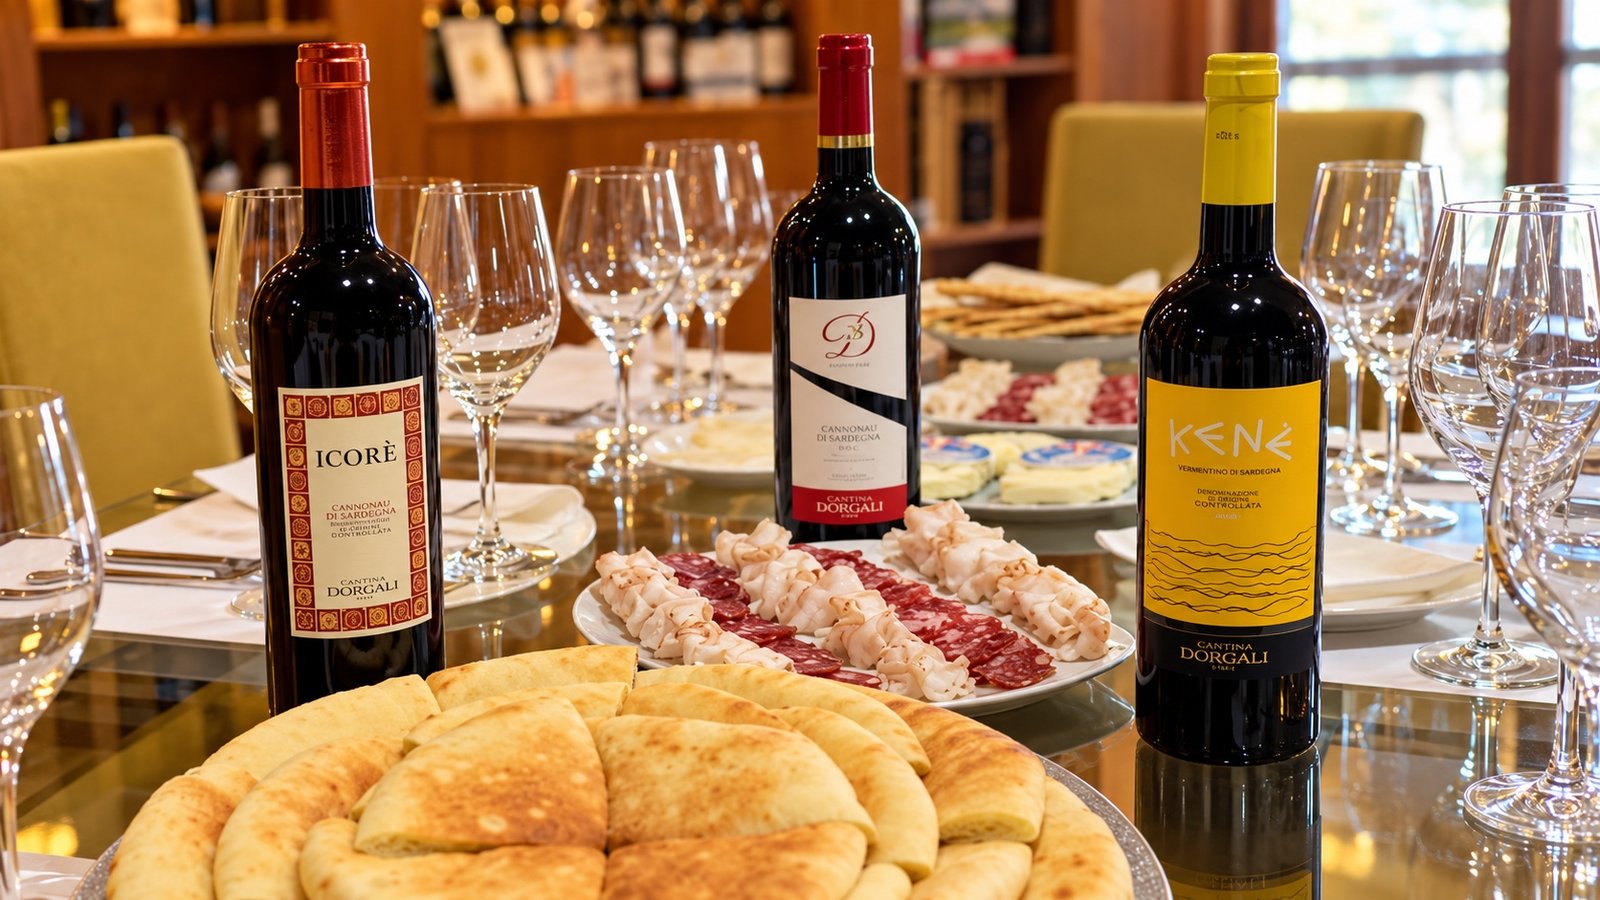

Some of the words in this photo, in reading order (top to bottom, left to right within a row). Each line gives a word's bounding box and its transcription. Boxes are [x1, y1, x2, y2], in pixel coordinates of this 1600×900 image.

[821, 424, 877, 433] CANNONAU
[817, 434, 826, 442] DI
[829, 433, 880, 442] SARDEGNA
[316, 440, 398, 468] ICORÈ
[1178, 464, 1228, 475] VERMENTINO
[1240, 468, 1281, 476] SARDEGNA
[827, 495, 873, 503] CANTINA
[331, 500, 391, 512] CANNONAU
[816, 501, 883, 514] DORGALI
[1194, 500, 1262, 509] CONTROLLATA
[340, 507, 397, 519] SARDEGNA
[340, 576, 386, 586] CANTINA
[327, 580, 398, 597] DORGALI
[1197, 641, 1253, 651] CANTINA
[1180, 646, 1268, 664] DORGALI
